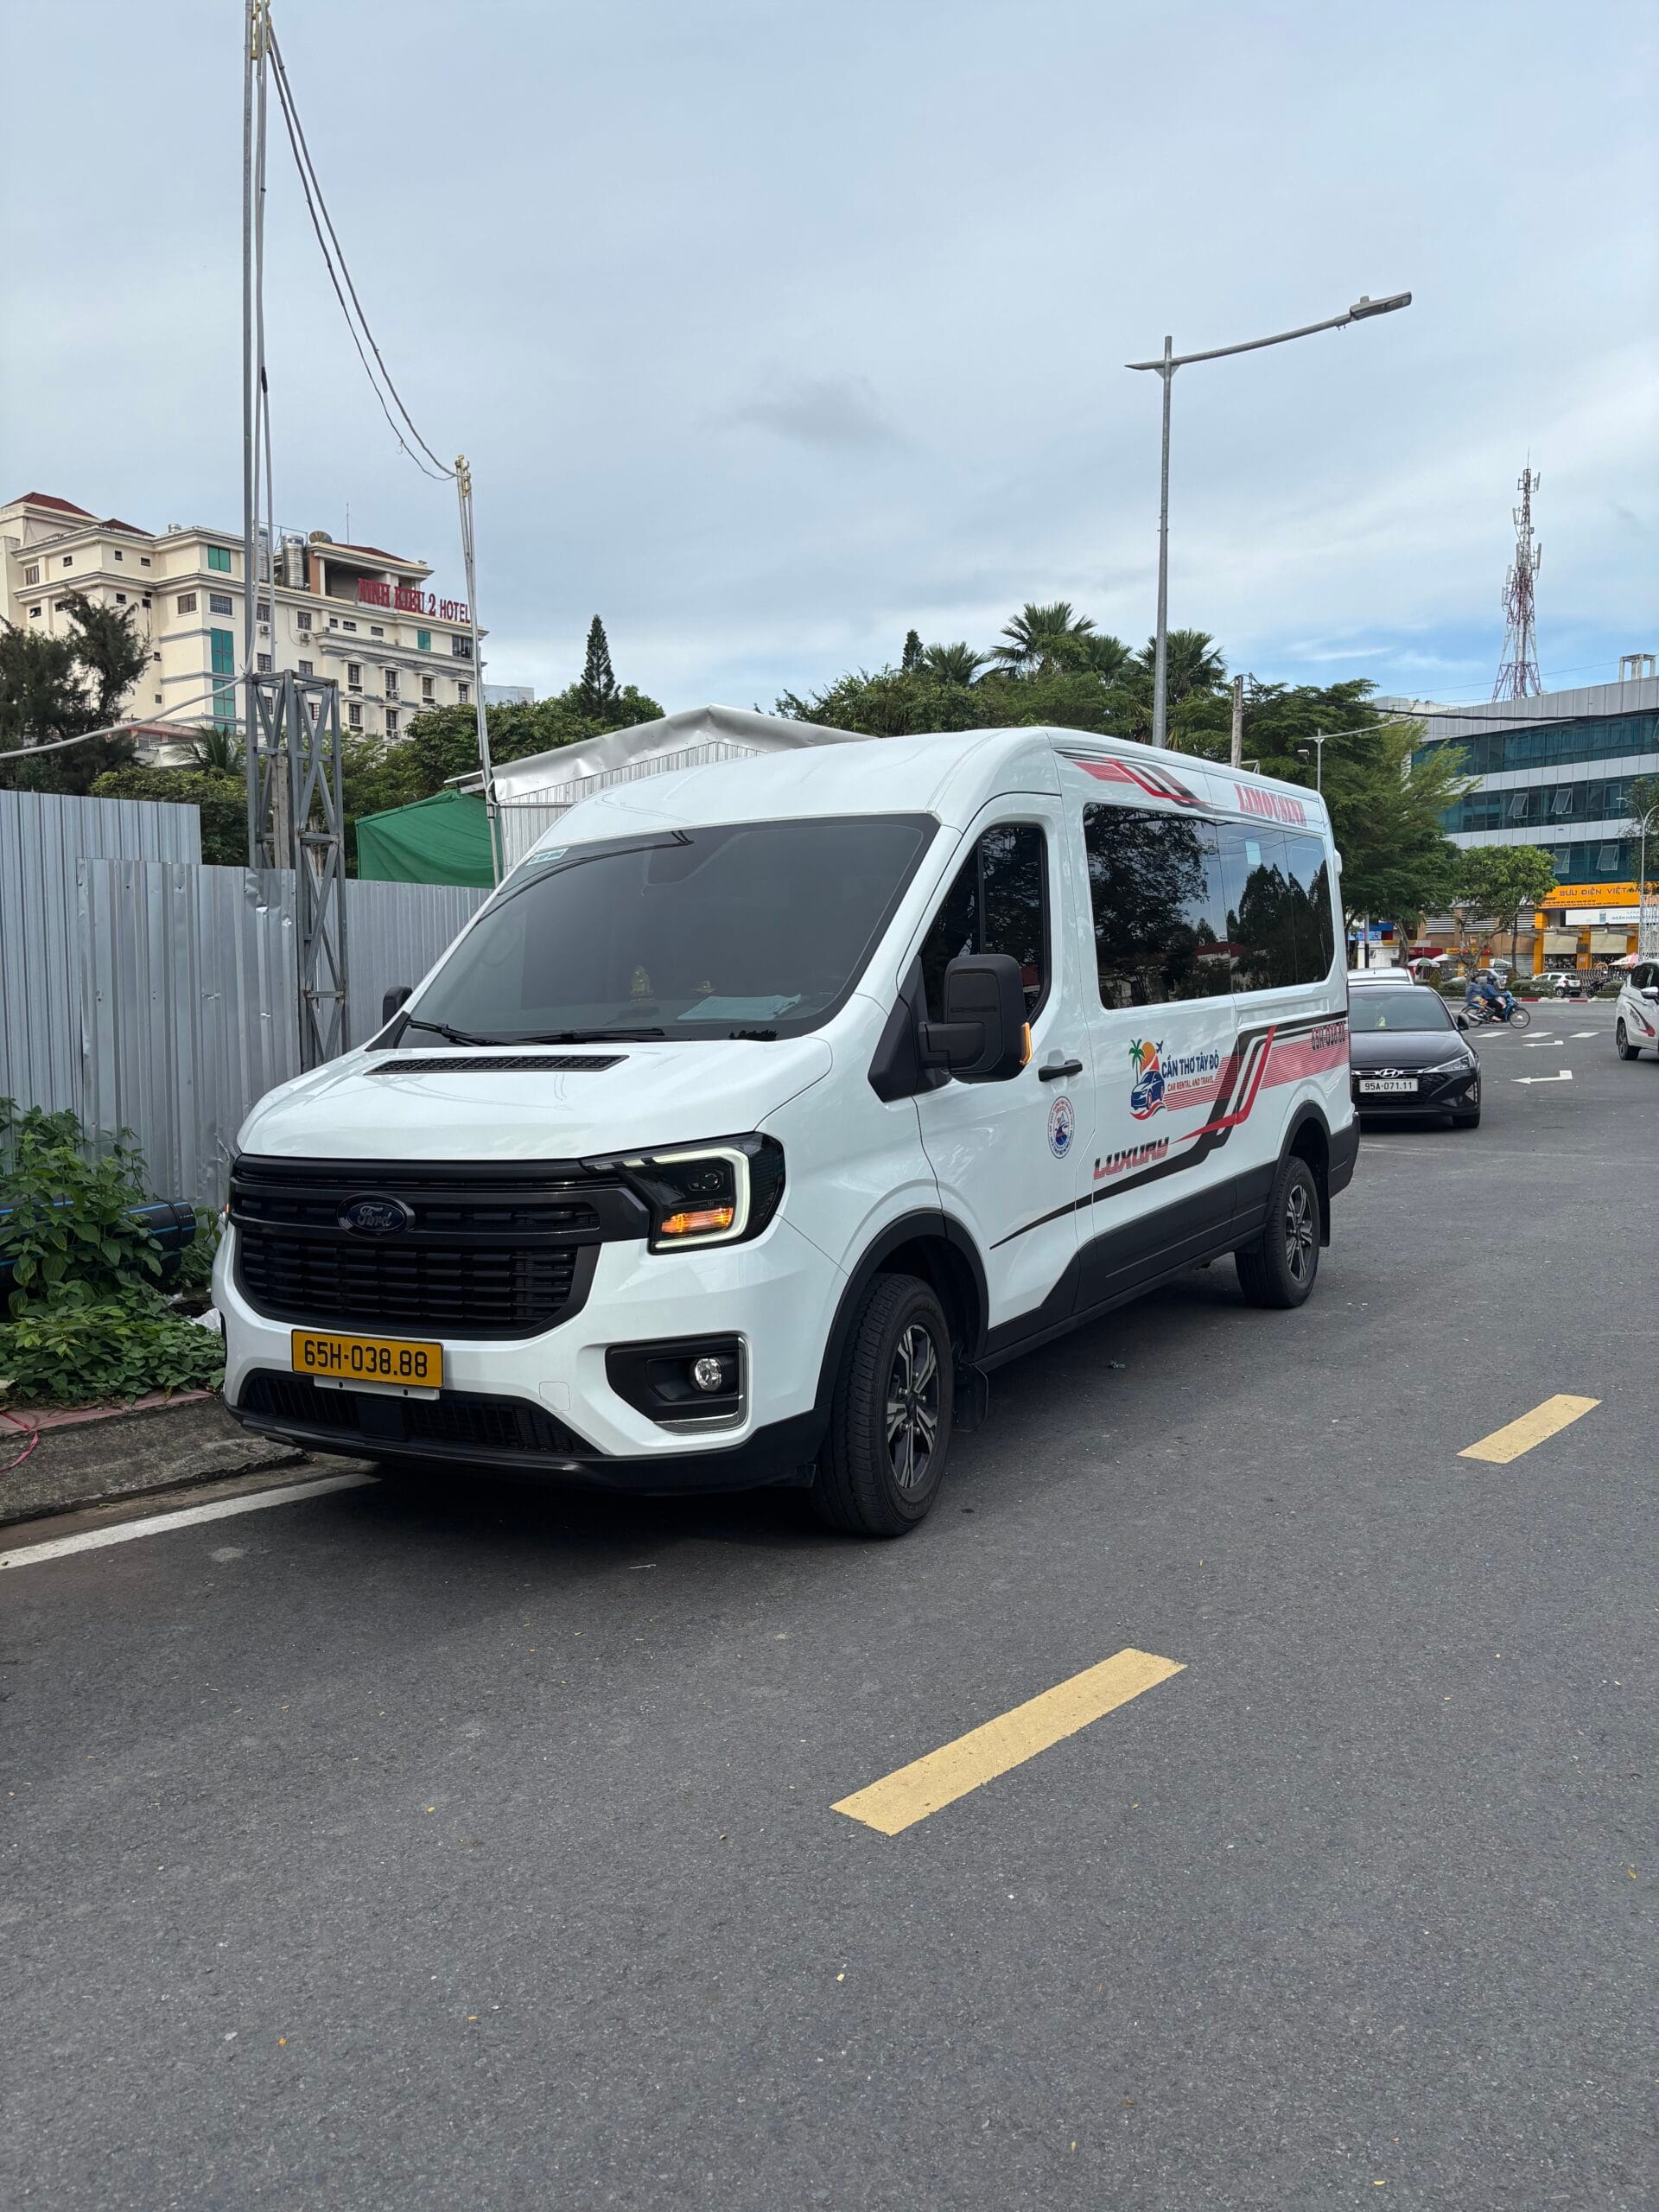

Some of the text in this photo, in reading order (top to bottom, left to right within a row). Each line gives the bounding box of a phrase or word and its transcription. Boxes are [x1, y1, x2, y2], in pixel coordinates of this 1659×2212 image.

[358, 577, 391, 607] NINH
[428, 593, 436, 616] 2
[440, 599, 471, 623] HOTEL
[1233, 783, 1307, 827] LIMOUSINE
[1161, 1049, 1219, 1078] CẦN THƠ TÂY ĐÔ
[1167, 1083, 1176, 1092] CAR
[1176, 1079, 1192, 1090] RENTAL
[1192, 1077, 1200, 1086] AND
[1364, 1081, 1413, 1091] 95A-071.11
[1094, 1136, 1169, 1180] LUXURY
[357, 1205, 392, 1227] Ford
[304, 1339, 428, 1378] 65H-038.88
